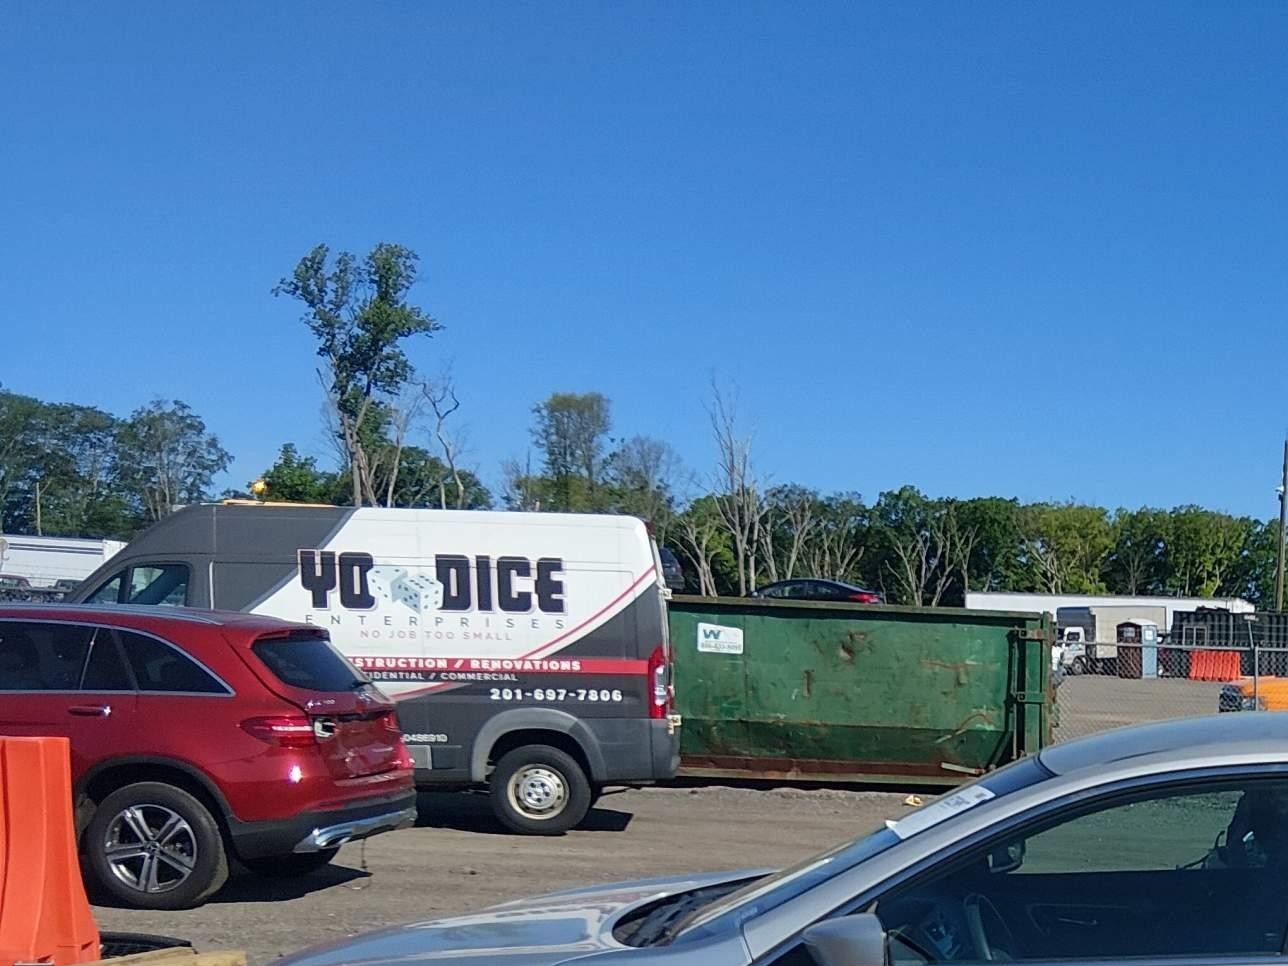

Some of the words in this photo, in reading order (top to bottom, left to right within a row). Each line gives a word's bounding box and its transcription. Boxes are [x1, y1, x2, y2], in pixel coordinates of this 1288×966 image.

[435, 553, 568, 614] DICE
[305, 615, 567, 629] ENTERPRISES
[360, 630, 381, 639] NO
[388, 631, 417, 639] JOB
[426, 631, 459, 640] TOO
[463, 631, 512, 641] SMALL
[470, 659, 581, 671] RENOVATIONS
[440, 672, 519, 681] COMMERCIAL
[490, 688, 623, 701] 201-697-7806
